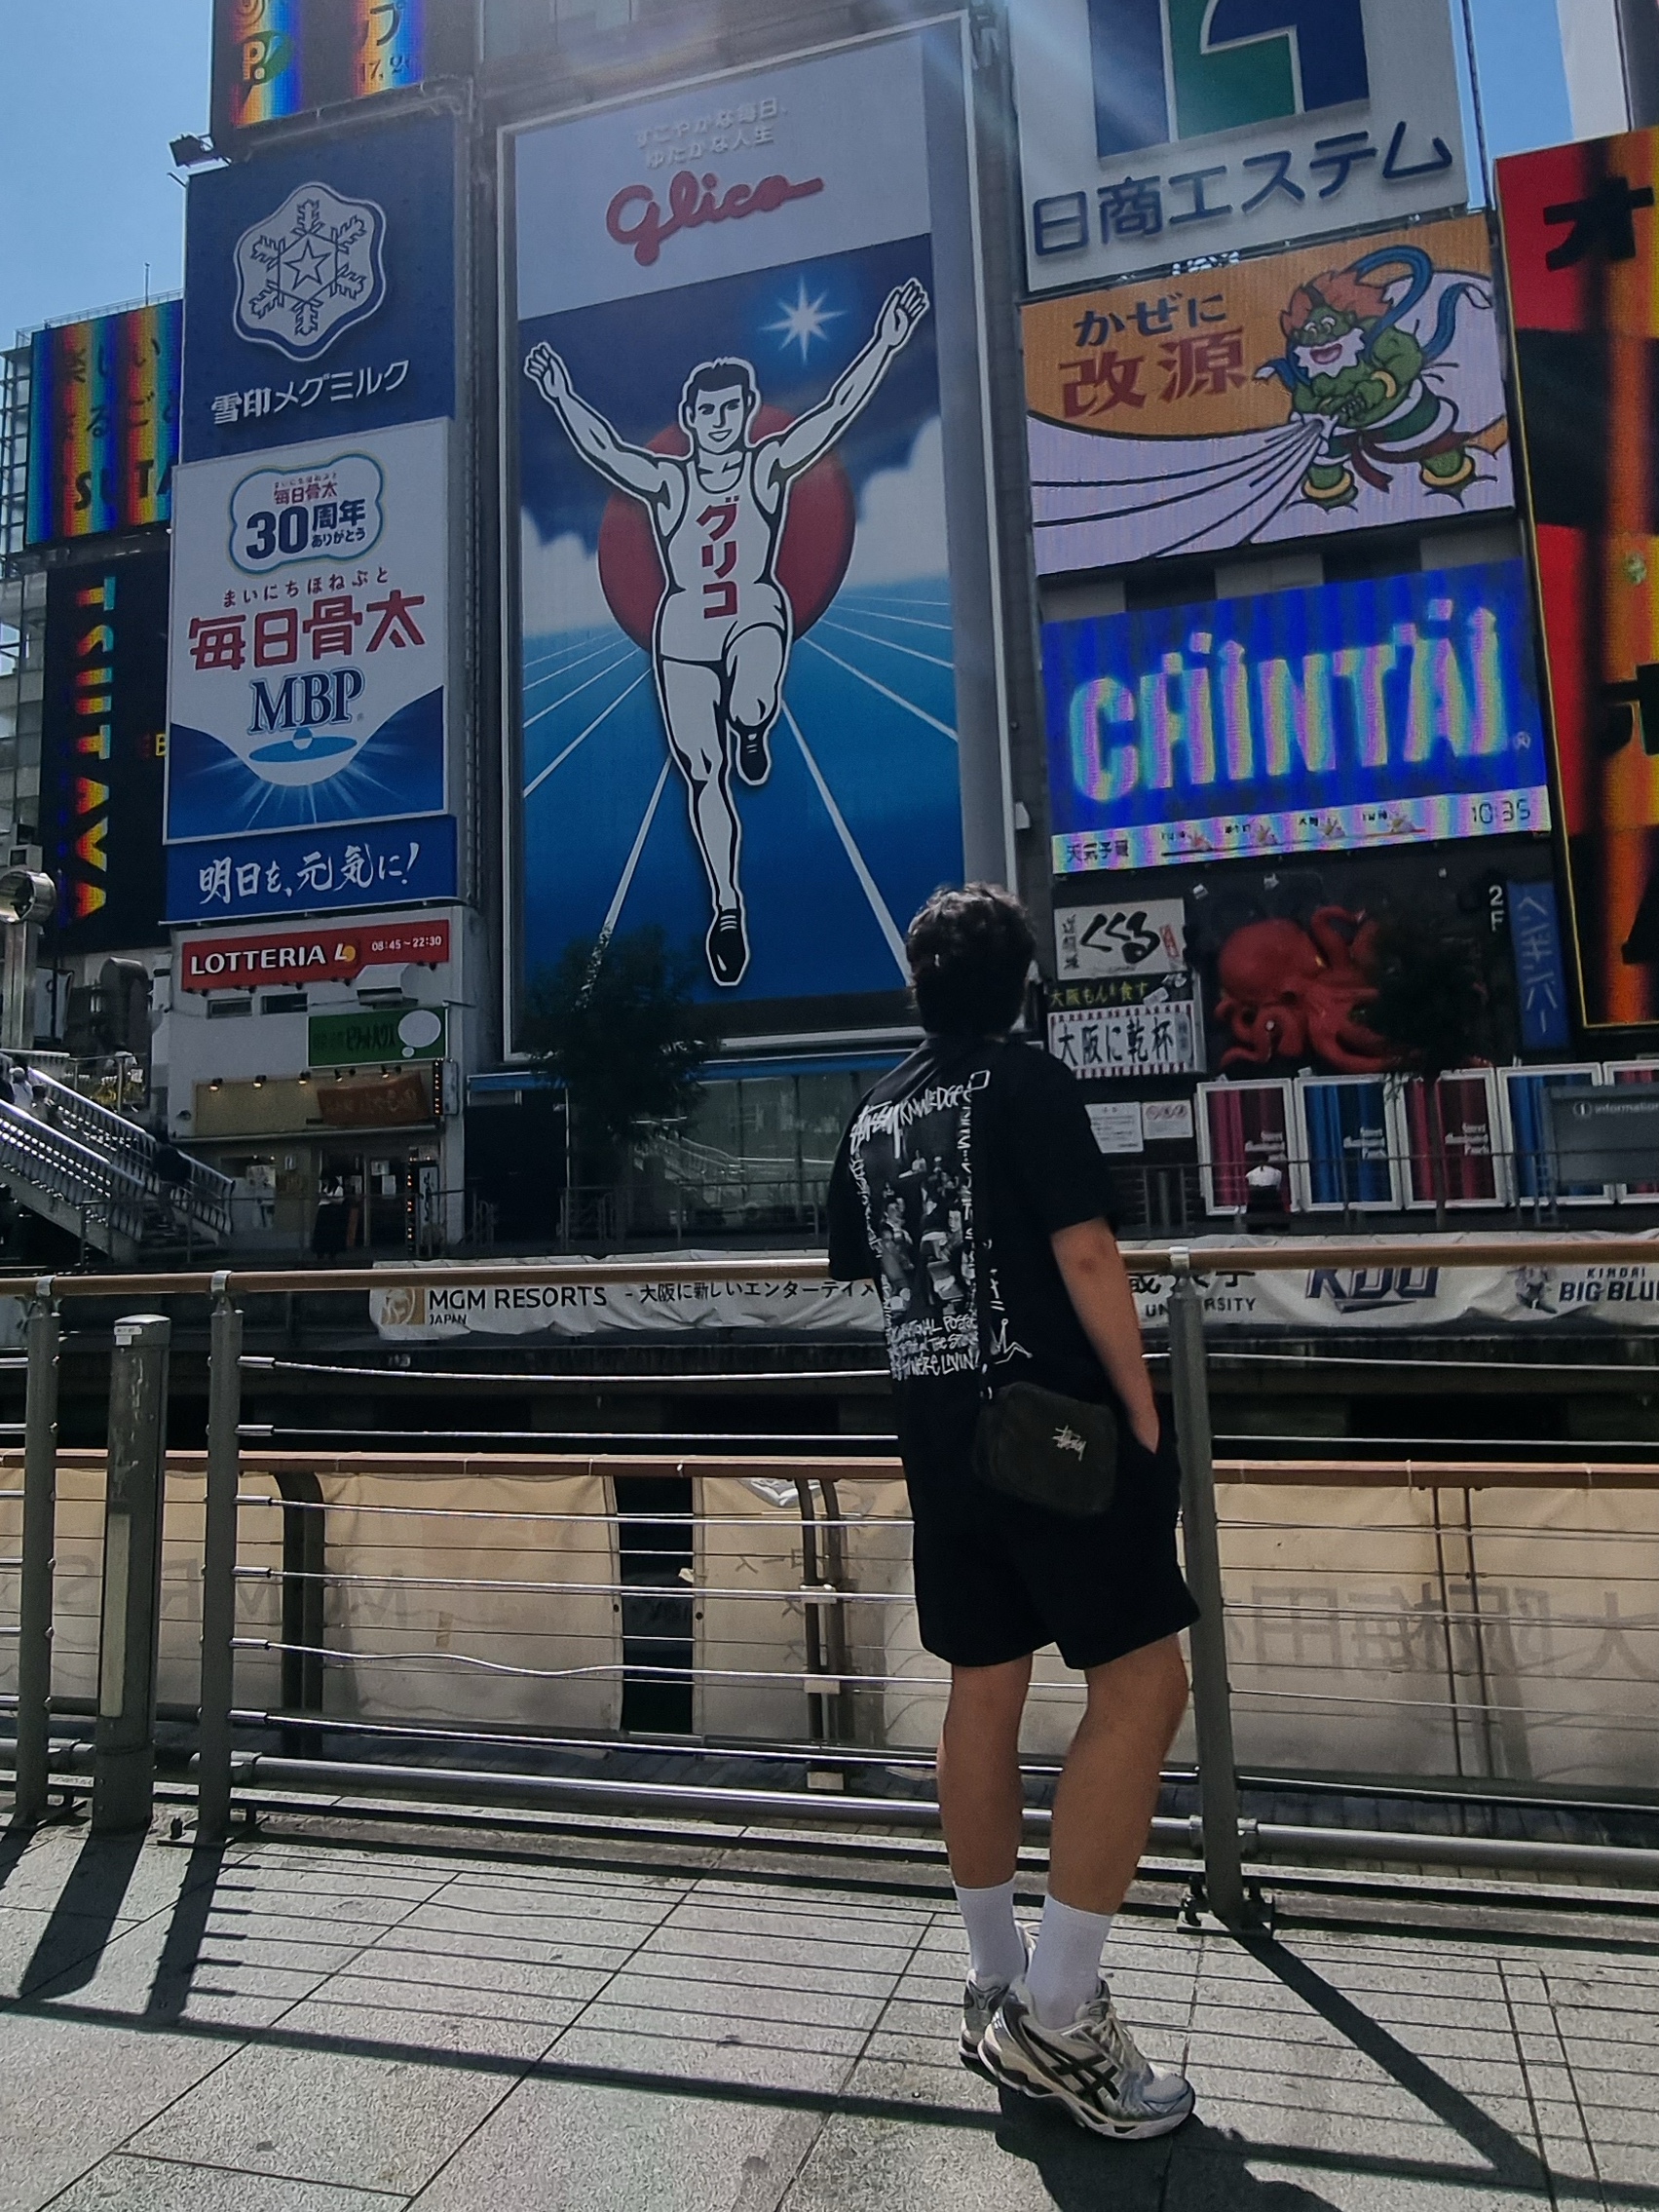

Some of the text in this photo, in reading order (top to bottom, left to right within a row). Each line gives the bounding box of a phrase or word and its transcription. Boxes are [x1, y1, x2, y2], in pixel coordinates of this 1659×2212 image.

[1033, 121, 1453, 257] 日商エステム
[1075, 292, 1226, 348] かぜに
[211, 360, 409, 425] 雪印メグミルク
[1059, 326, 1253, 420] 改源
[311, 527, 366, 549] ありがとう
[696, 495, 740, 620] グリコ
[223, 566, 390, 608] まいにちほねぶと
[188, 589, 426, 671] 毎日骨太
[248, 667, 365, 735] MBP
[191, 944, 326, 975] LOTTERIA
[1080, 911, 1161, 965] くくる
[429, 1286, 608, 1311] MGM RESORTS
[1559, 1280, 1604, 1303] BIG
[429, 1314, 468, 1325] JAPAN
